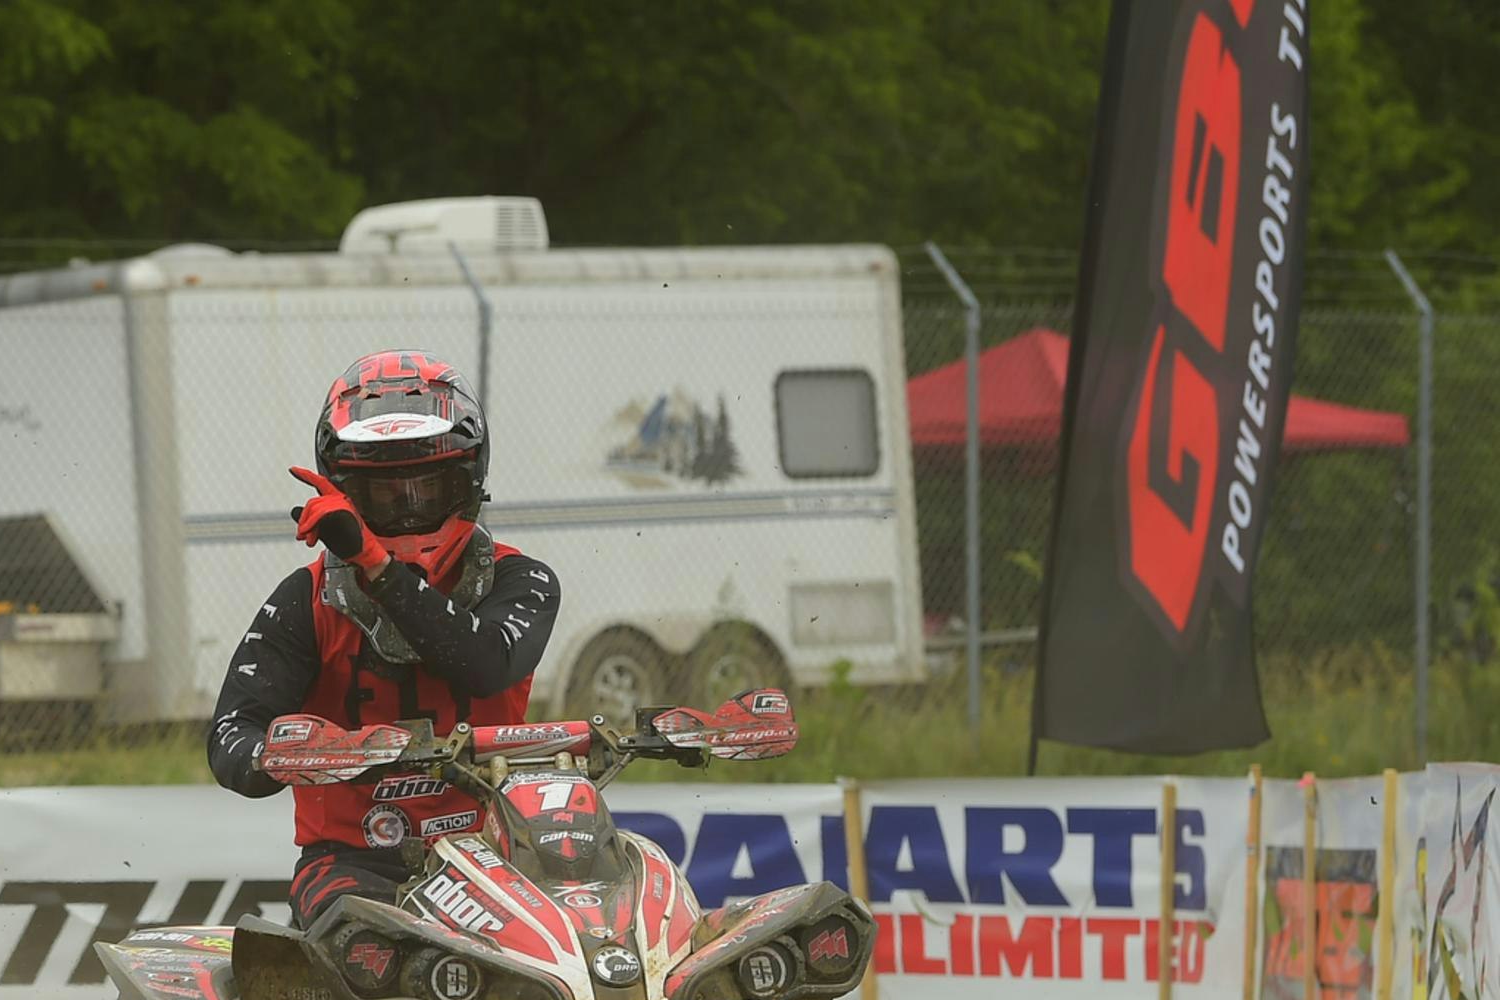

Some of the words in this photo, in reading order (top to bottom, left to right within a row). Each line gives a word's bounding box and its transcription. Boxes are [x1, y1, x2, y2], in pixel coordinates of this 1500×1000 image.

[1127, 0, 1256, 635] GB
[1221, 104, 1300, 575] POWERSPORTS
[1277, 0, 1303, 71] TI
[426, 815, 472, 833] ACTION
[536, 782, 574, 811] 1
[540, 831, 594, 844] can-am
[862, 805, 1207, 911] ARTS
[423, 874, 504, 932] obor
[874, 912, 1206, 985] LIMITED
